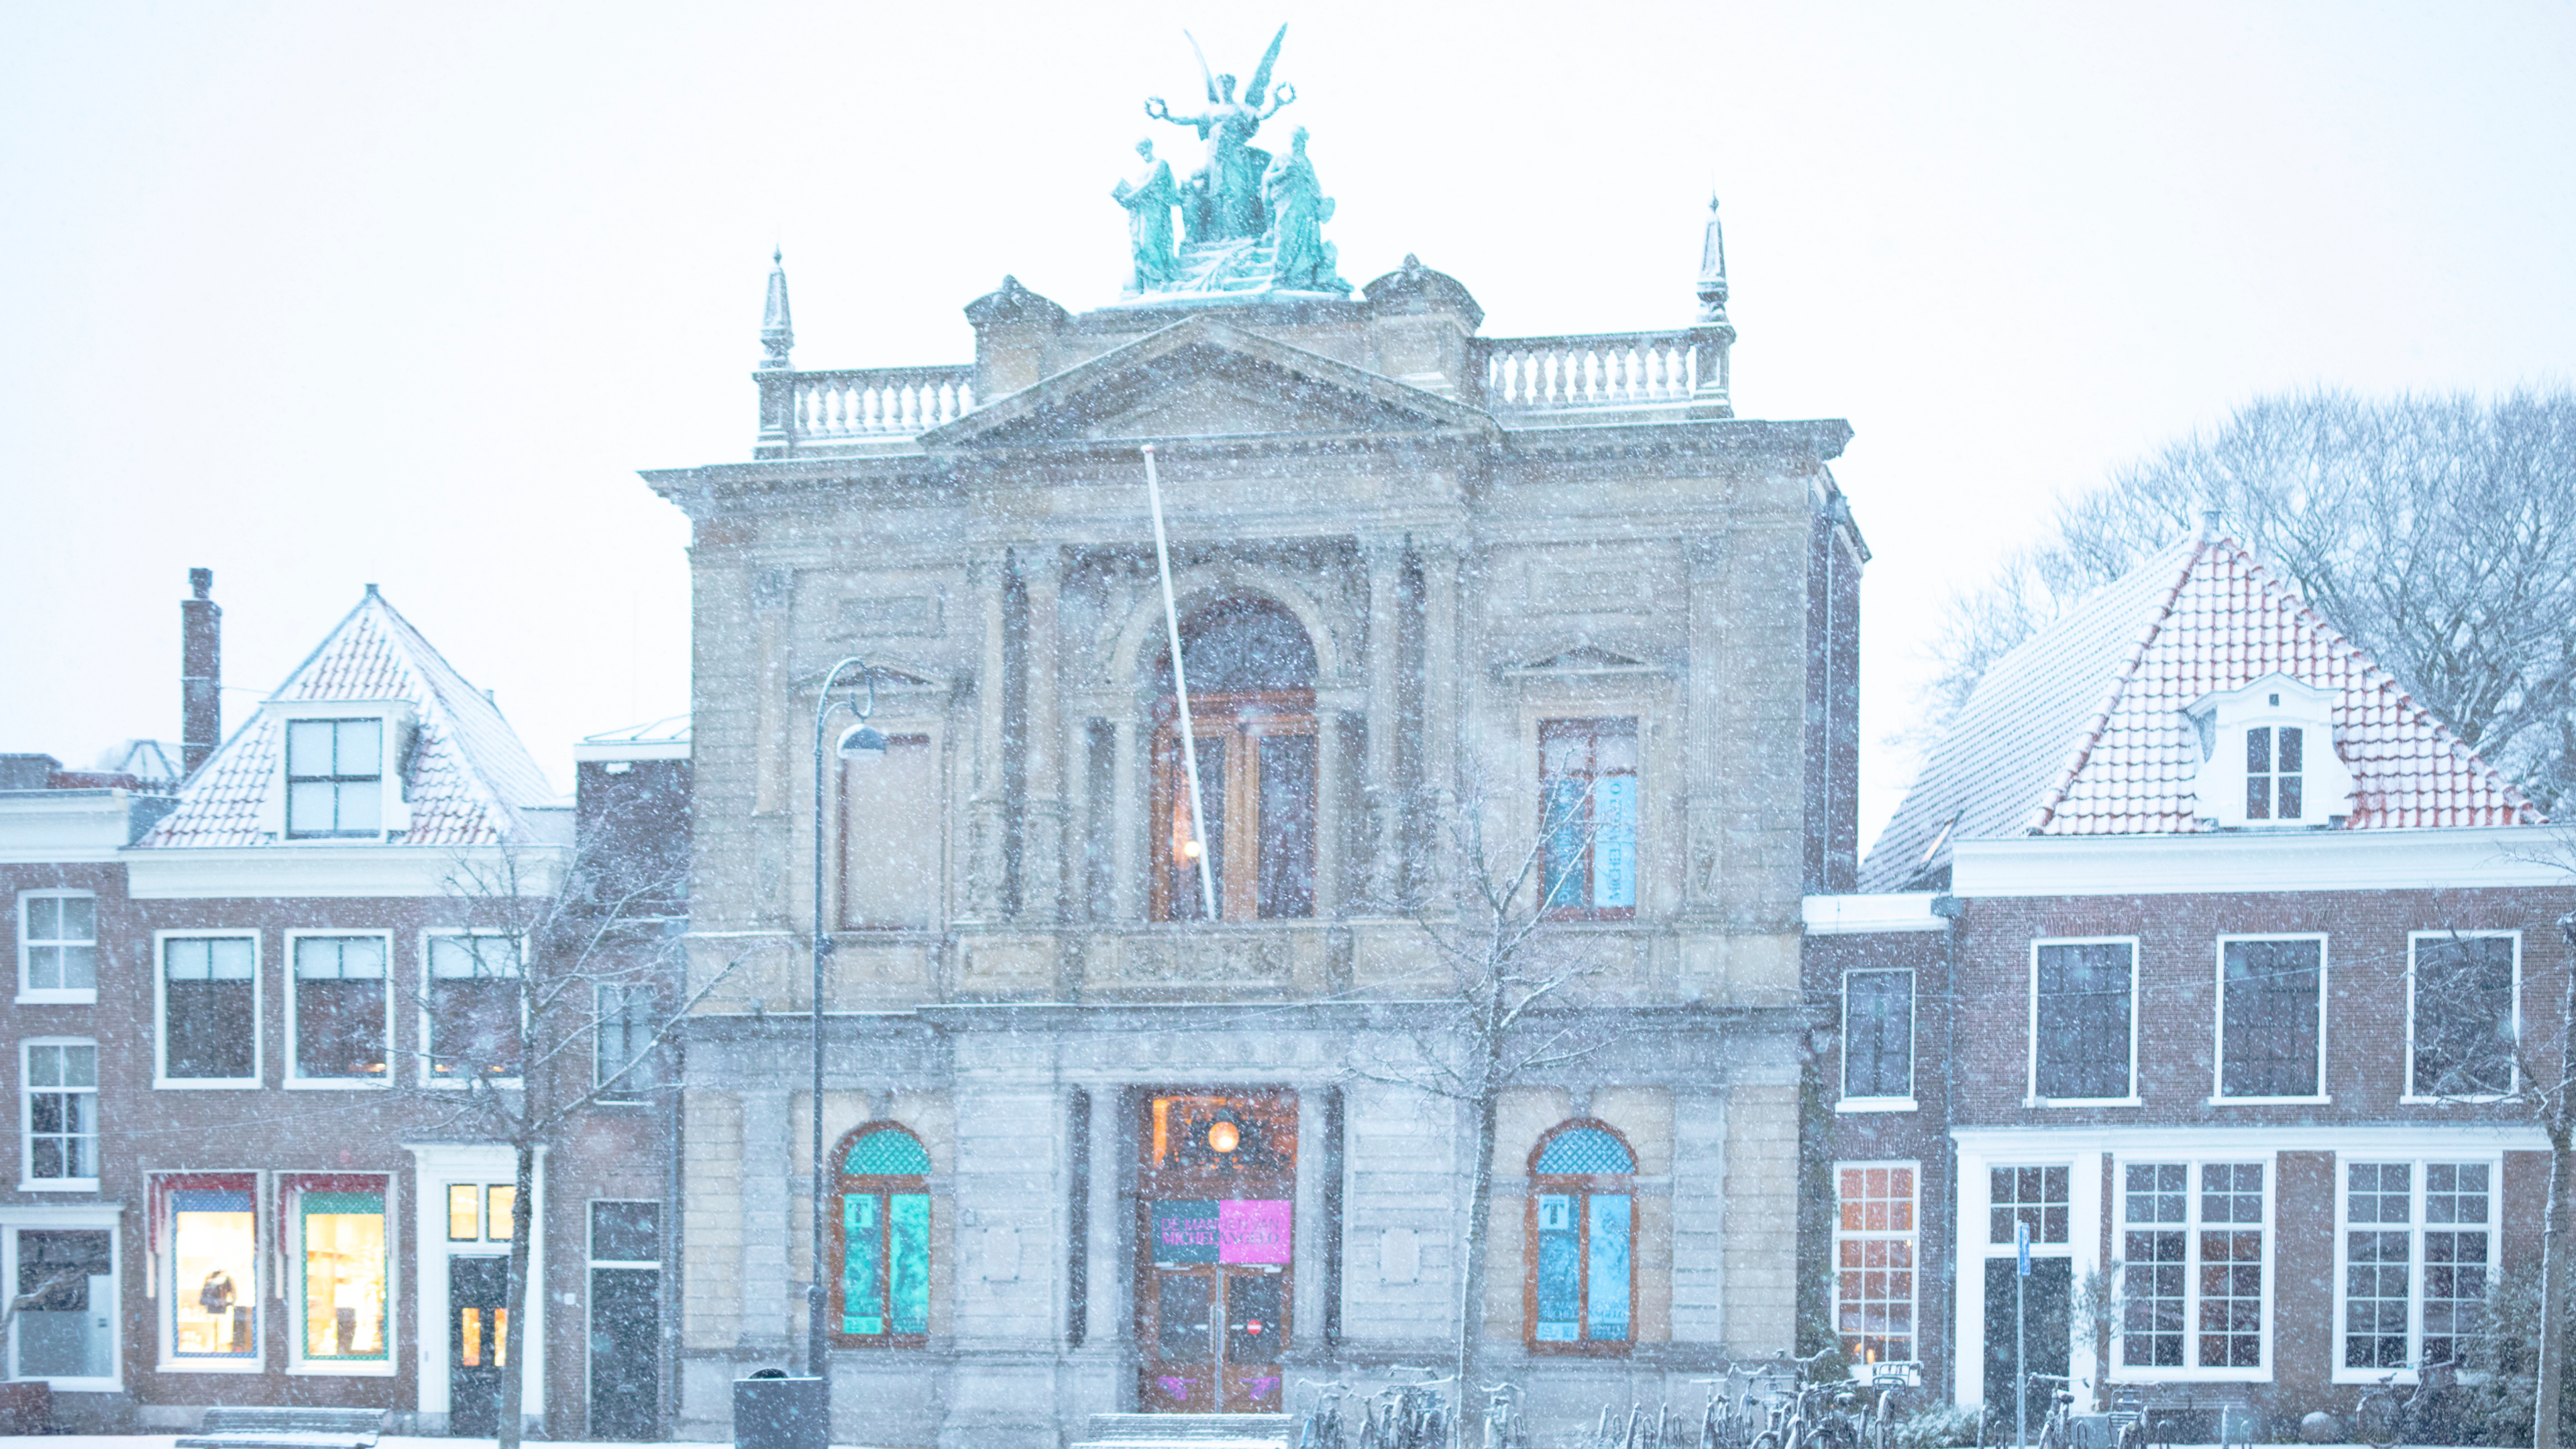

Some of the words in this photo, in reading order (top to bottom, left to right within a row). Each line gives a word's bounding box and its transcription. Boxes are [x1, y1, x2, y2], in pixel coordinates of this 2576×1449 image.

[1161, 1218, 1180, 1231] DE
[1185, 1217, 1246, 1230] MANNEN
[1250, 1216, 1279, 1230] VAN
[1162, 1232, 1279, 1245] MICHELANGELO
